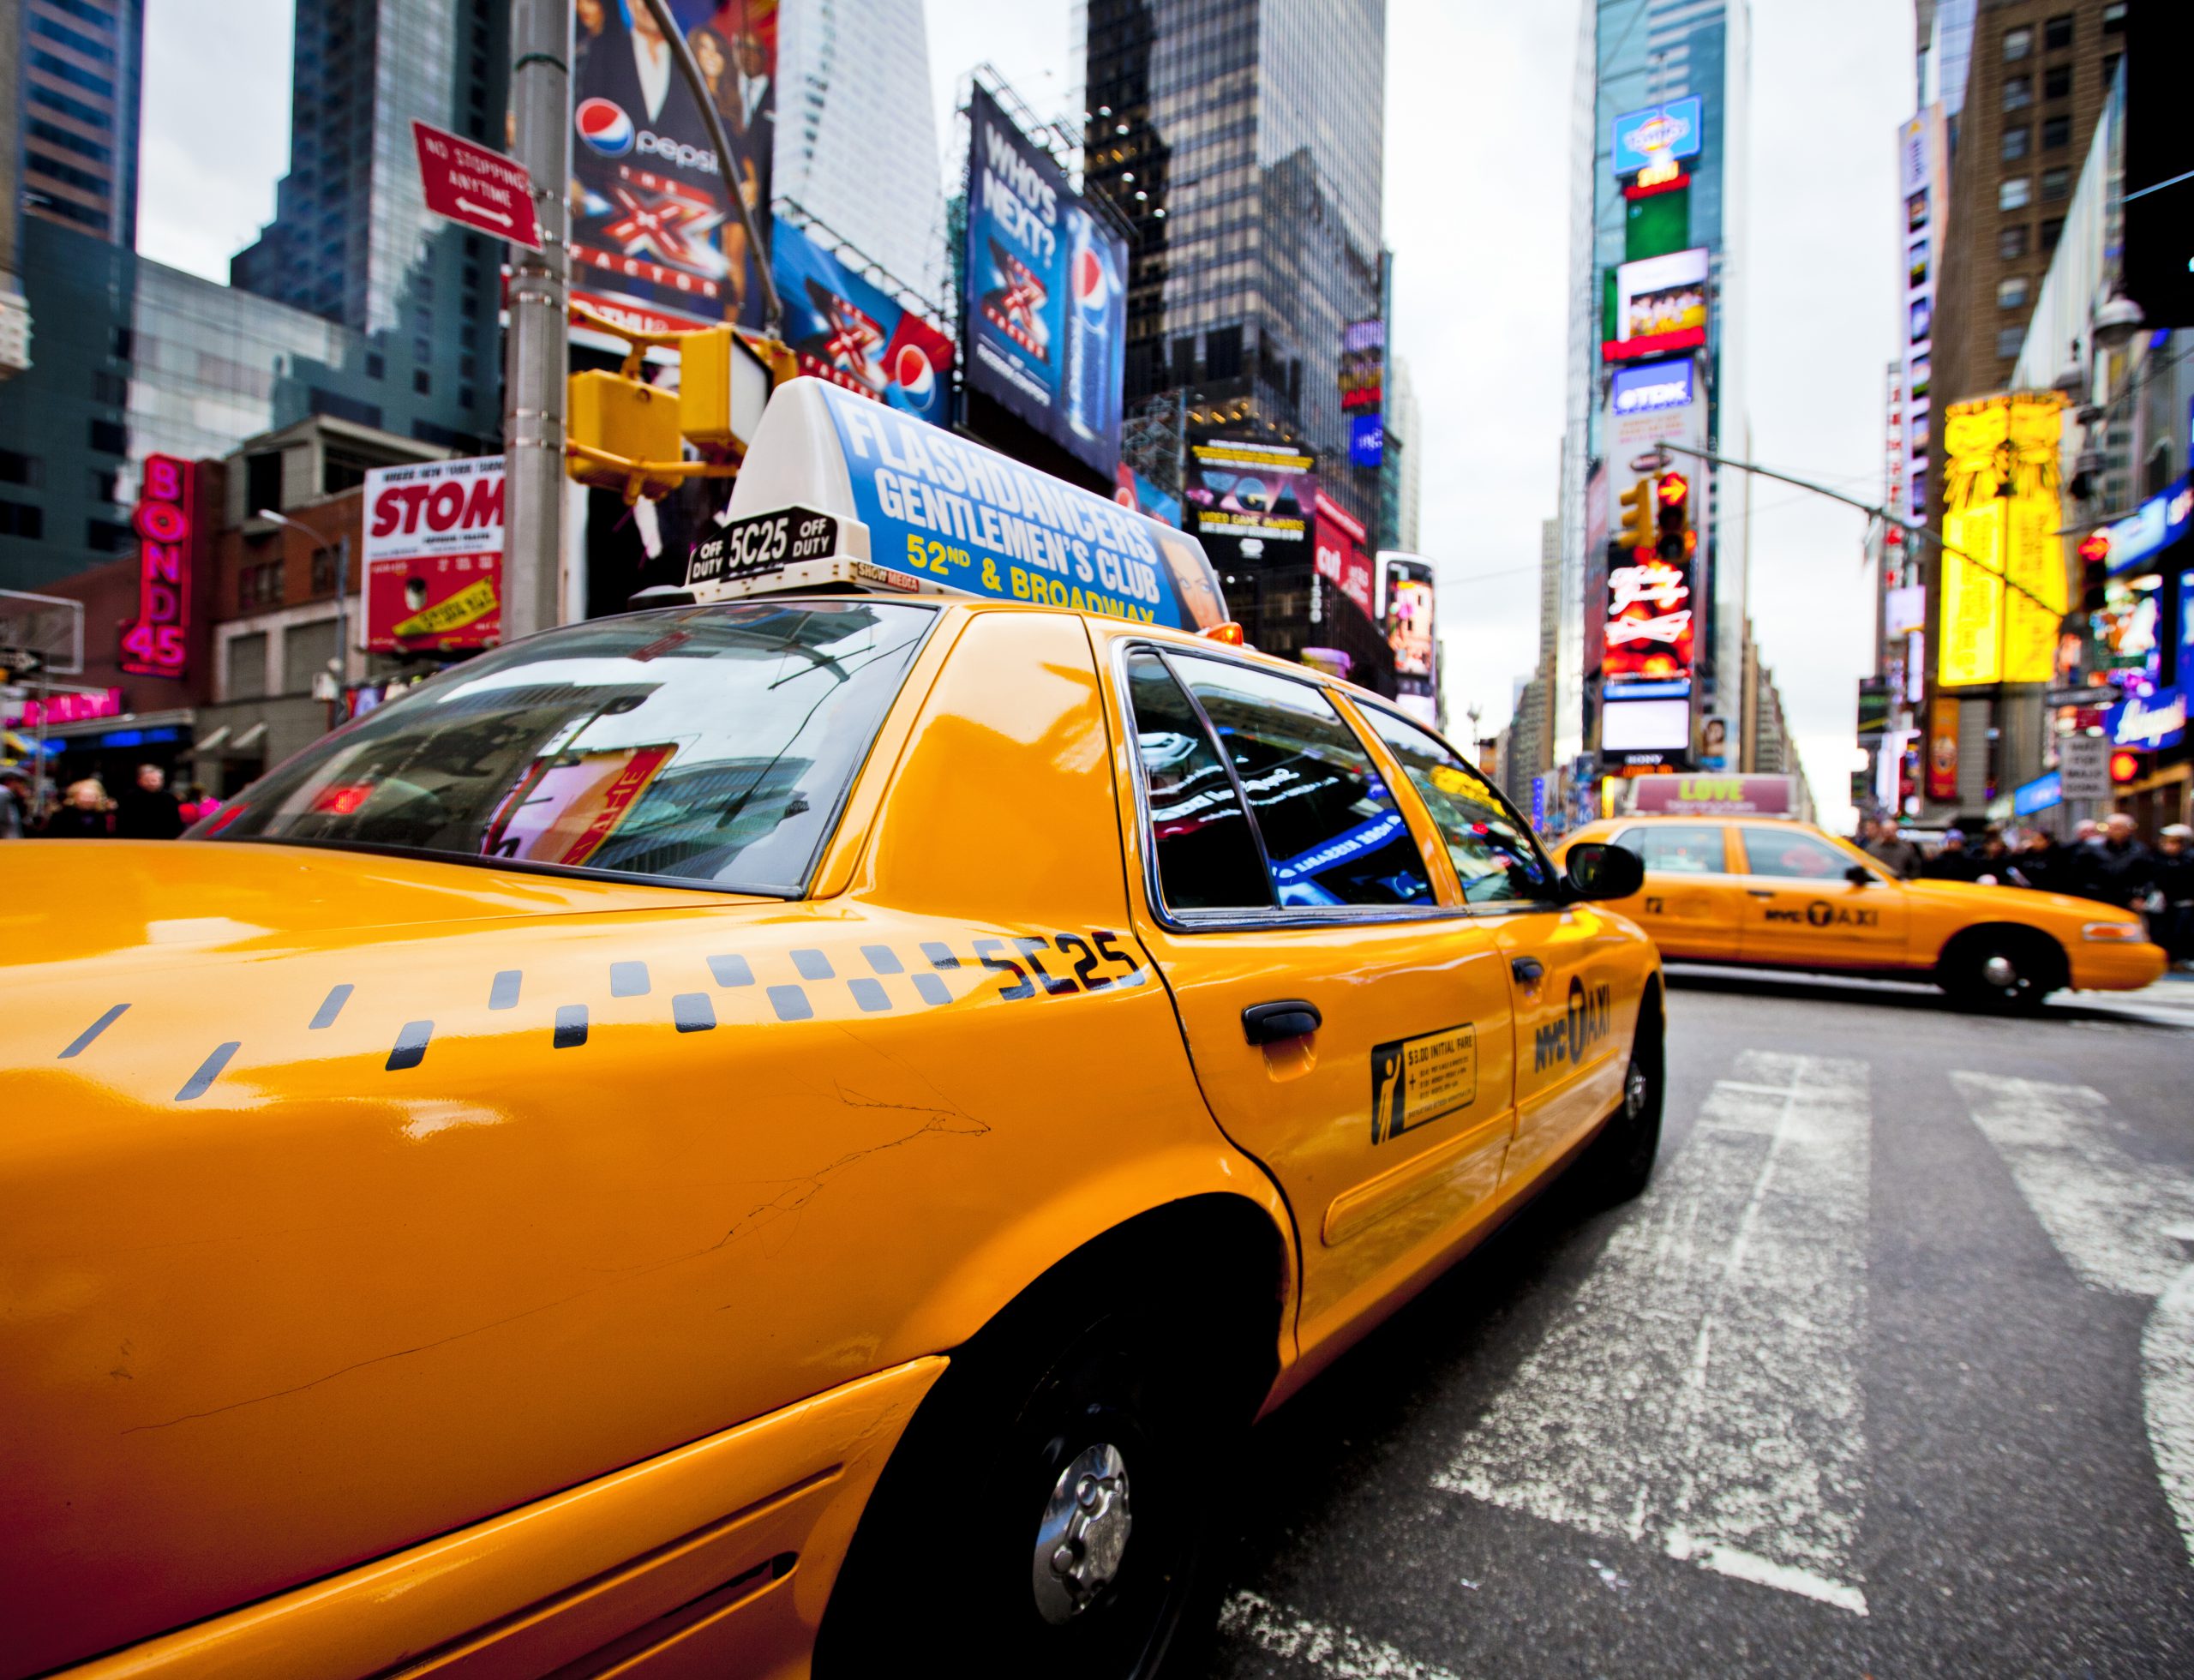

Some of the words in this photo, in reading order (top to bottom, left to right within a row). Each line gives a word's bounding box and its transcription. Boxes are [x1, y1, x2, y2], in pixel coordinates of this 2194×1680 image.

[424, 137, 449, 160] NO
[453, 148, 529, 193] STOPPING
[635, 129, 720, 175] pepsi
[986, 120, 1058, 229] WHO'S
[448, 170, 513, 208] ANYTIME
[618, 165, 680, 195] THE
[983, 166, 1056, 270] NEXT?
[569, 243, 719, 295] FACTOR
[835, 397, 1158, 566] FLASHDANCERS
[370, 477, 506, 538] STOM
[799, 518, 827, 537] OFF
[140, 462, 189, 624] BOND
[700, 540, 723, 558] OFF
[728, 517, 789, 568] 5C25
[793, 536, 830, 557] DUTY
[873, 467, 1094, 585] GENTLEMEN'S
[1094, 546, 1160, 605] CLUB
[692, 557, 724, 579] DUTY
[858, 562, 887, 583] SHOW
[888, 571, 919, 591] MEDIA
[906, 533, 971, 576] 52ND
[981, 557, 1003, 592] &
[1010, 567, 1156, 624] BROADWAY
[122, 624, 186, 668] 45
[1679, 778, 1743, 802] LOVE
[972, 931, 1146, 1001] 5C25
[1408, 1047, 1430, 1066] $3.00
[1430, 1038, 1455, 1059] INITIAL
[1456, 1035, 1472, 1051] FARE
[1534, 1018, 1567, 1074] NYC
